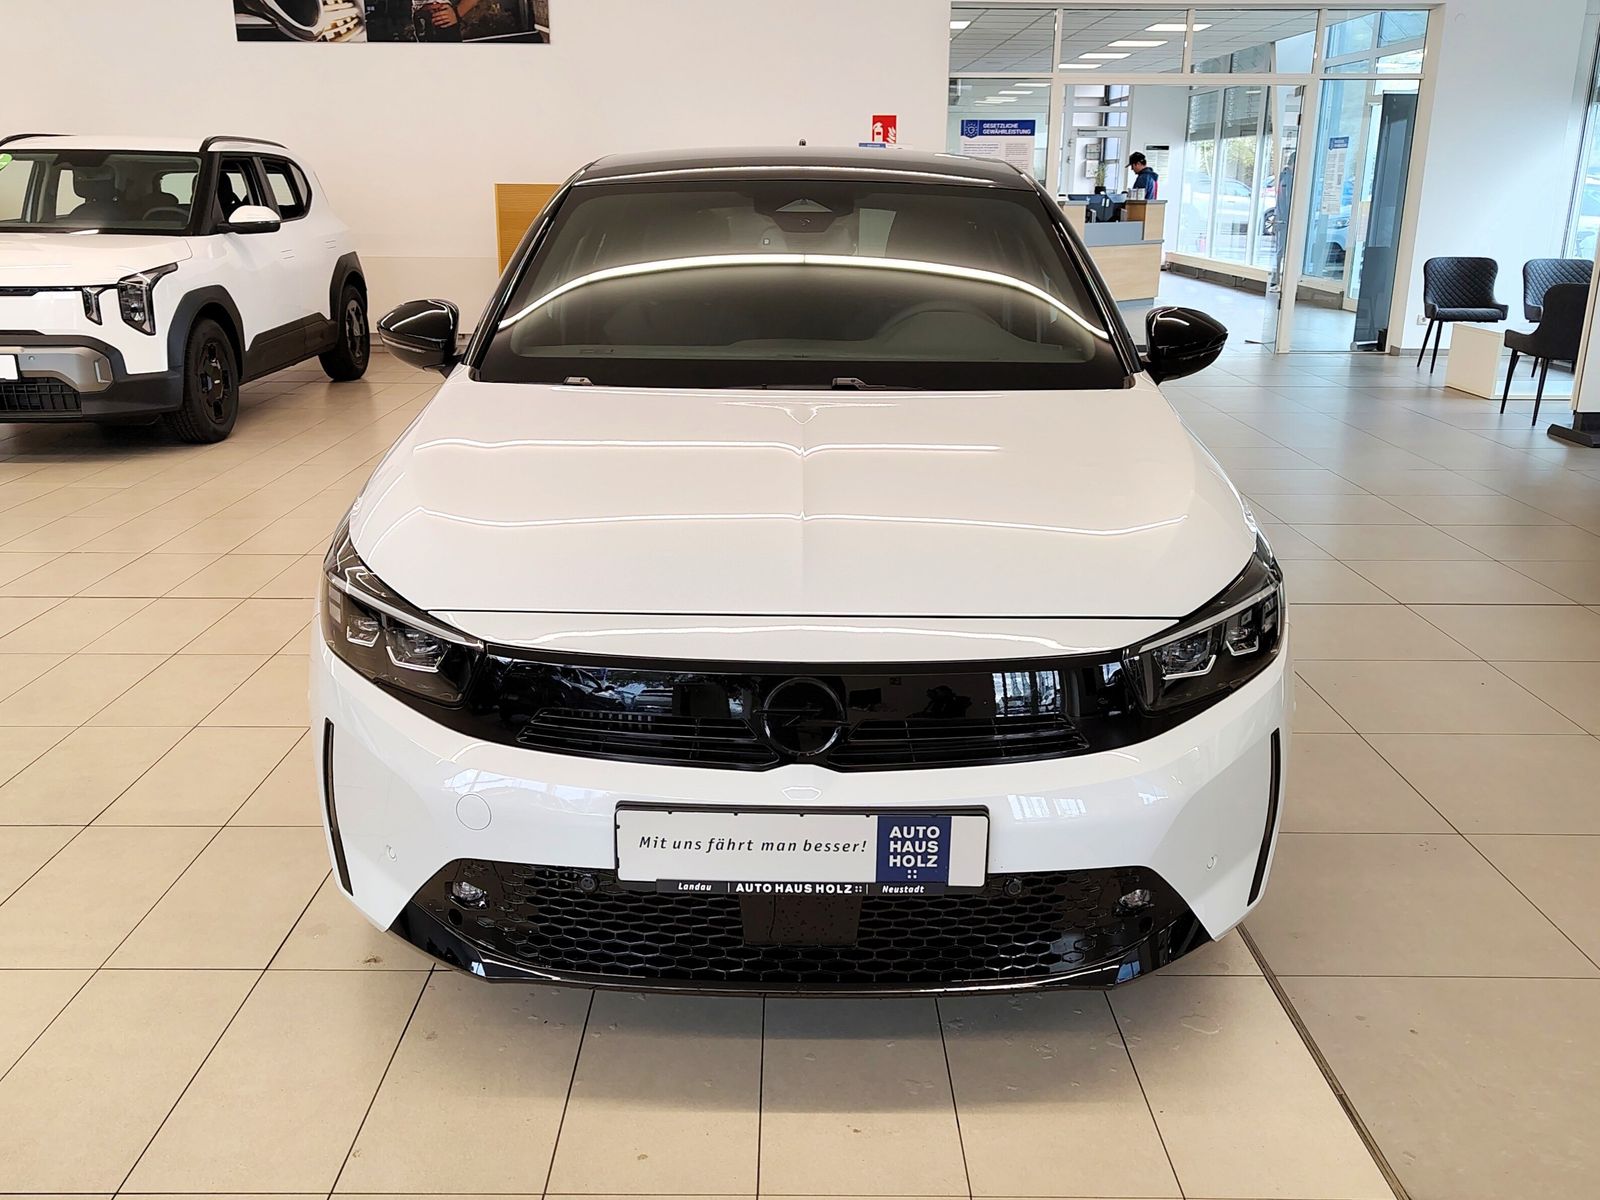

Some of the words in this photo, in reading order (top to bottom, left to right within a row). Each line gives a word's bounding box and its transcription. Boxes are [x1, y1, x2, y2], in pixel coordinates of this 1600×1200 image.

[889, 826, 940, 839] AUTO
[639, 836, 667, 849] Mit
[672, 840, 702, 850] uns
[706, 838, 753, 853] fährt
[761, 840, 797, 851] man
[803, 839, 867, 852] besser!
[889, 840, 939, 853] HAUS
[889, 854, 938, 867] HOLZ
[678, 882, 712, 891] Landau
[815, 883, 852, 894] HOLZ
[882, 885, 925, 894] Neustadt
